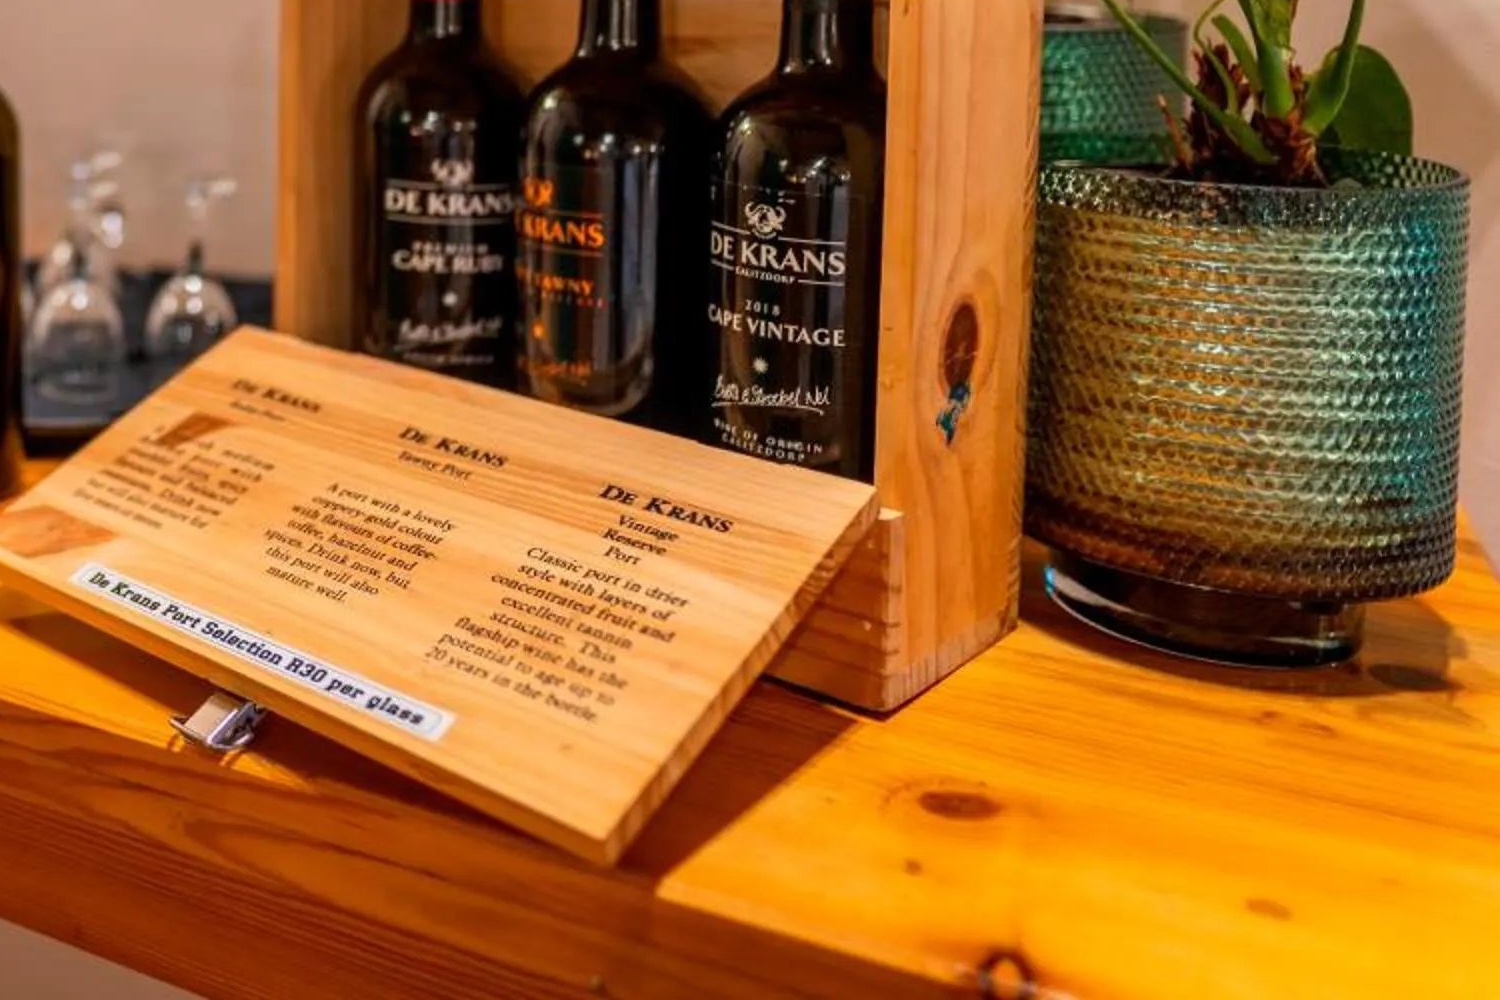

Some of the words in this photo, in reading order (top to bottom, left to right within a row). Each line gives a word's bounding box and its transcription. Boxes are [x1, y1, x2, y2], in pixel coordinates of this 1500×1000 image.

[385, 187, 422, 214] DE
[427, 190, 513, 217] KRANS
[711, 230, 734, 260] DE
[741, 240, 845, 276] KRANS
[735, 266, 795, 284] CALITZDORP
[708, 303, 742, 332] CAPE
[746, 316, 846, 347] VINTAGE
[745, 300, 780, 317] 2018
[399, 427, 429, 444] DE
[435, 437, 508, 468] KRANS
[766, 436, 823, 453] ORIGIN
[439, 463, 472, 480] Port
[291, 504, 320, 520] with
[321, 513, 374, 540] flavours
[375, 530, 394, 545] of
[327, 483, 338, 494] A
[338, 488, 368, 504] port
[371, 496, 401, 515] with
[412, 510, 456, 533] lovely
[599, 483, 639, 507] DE
[642, 497, 735, 534] KRANS
[617, 514, 680, 543] Vintage
[327, 533, 385, 561] hazelnut
[387, 553, 418, 572] and
[398, 519, 444, 546] colour
[602, 527, 667, 556] Reserve
[265, 546, 290, 563] this
[291, 557, 322, 573] port
[323, 565, 350, 584] will
[349, 576, 380, 595] also
[307, 542, 349, 566] Drink
[350, 559, 382, 580] now,
[385, 570, 411, 590] but
[527, 546, 583, 574] Classic
[584, 567, 622, 589] port
[624, 577, 642, 594] in
[645, 585, 689, 609] drier
[604, 546, 642, 566] Port
[266, 565, 314, 589] mature
[315, 582, 347, 603] well.
[518, 562, 556, 583] style
[559, 577, 595, 598] with
[599, 588, 648, 617] layers
[651, 606, 674, 623] of
[490, 573, 596, 617] concentrated
[595, 602, 637, 633] fruit
[639, 624, 677, 645] and
[500, 596, 574, 630] excellent
[577, 621, 633, 651] tannin
[88, 570, 110, 590] De
[110, 576, 161, 611] Krans
[162, 602, 201, 630] Port
[201, 620, 284, 667] Selection
[285, 656, 328, 684] R30
[325, 676, 366, 698] per
[364, 694, 426, 726] glass
[454, 616, 520, 650] flagship
[523, 641, 564, 666] wine
[565, 655, 595, 679] has
[599, 668, 629, 690] the
[489, 610, 567, 647] structure.
[577, 640, 617, 664] This
[425, 646, 447, 662] 20
[449, 654, 489, 679] years
[491, 670, 511, 686] in
[513, 677, 544, 700] the
[437, 633, 514, 667] potential
[514, 659, 534, 676] to
[535, 671, 566, 688] age
[568, 681, 593, 699] up
[595, 690, 616, 706] to
